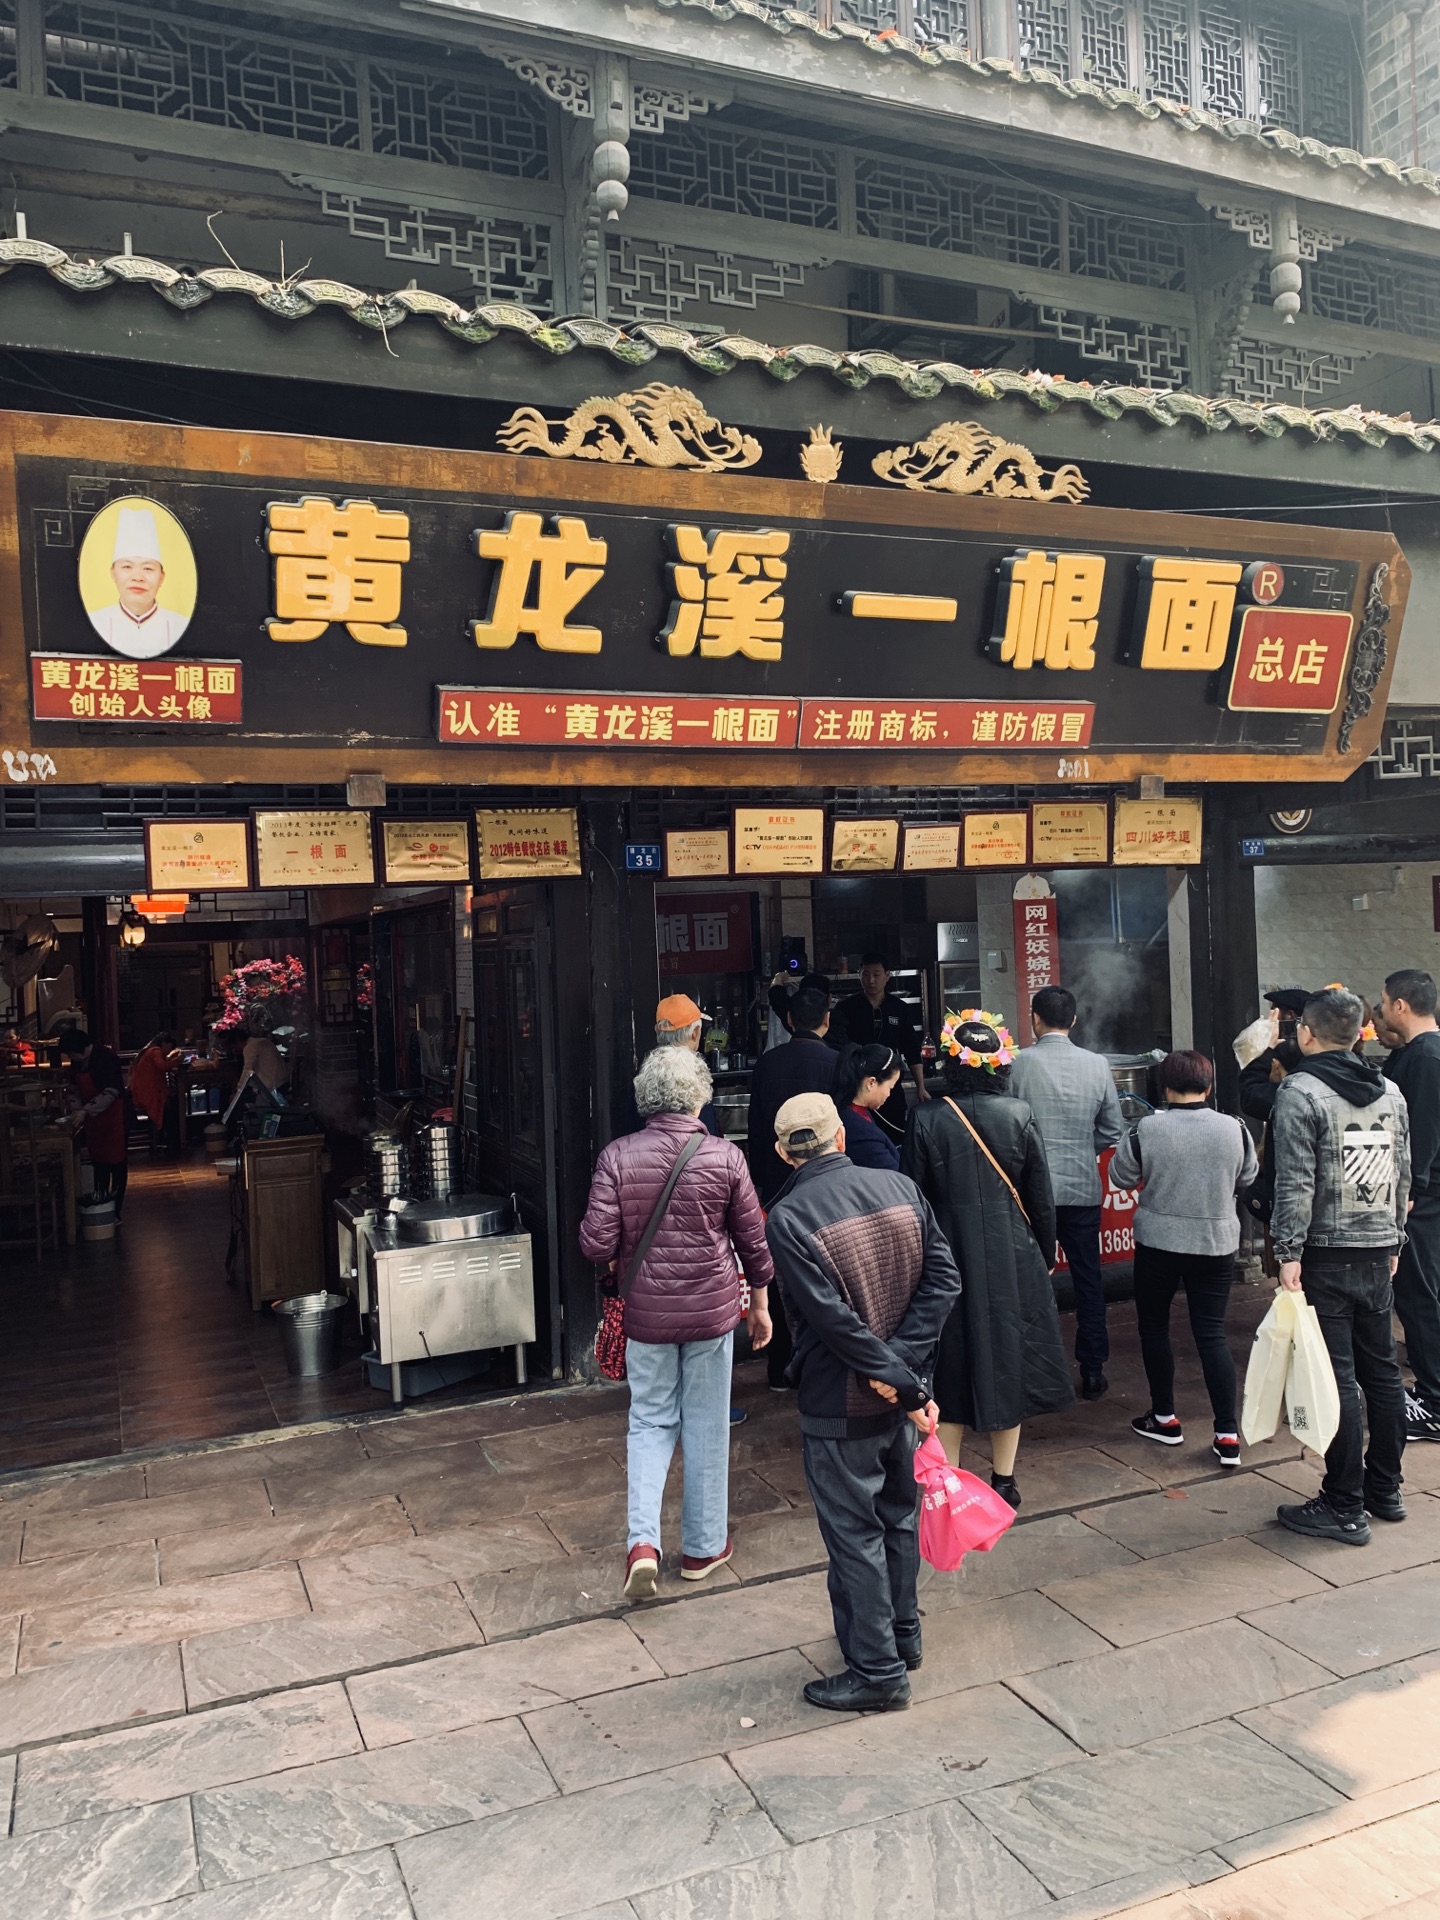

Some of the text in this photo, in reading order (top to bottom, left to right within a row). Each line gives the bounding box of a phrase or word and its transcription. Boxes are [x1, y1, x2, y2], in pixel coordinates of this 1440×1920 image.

[265, 496, 1242, 671] 黄龙溪一根面
[1248, 636, 1329, 685] 总店
[40, 660, 235, 694] 黄龙溪一根面
[69, 692, 212, 719] 创始人头像
[1125, 830, 1191, 844] 四川好味道
[286, 844, 347, 859] 一根面
[490, 840, 568, 857] 2012特色餐饮名店 推荐
[636, 854, 652, 867] 35
